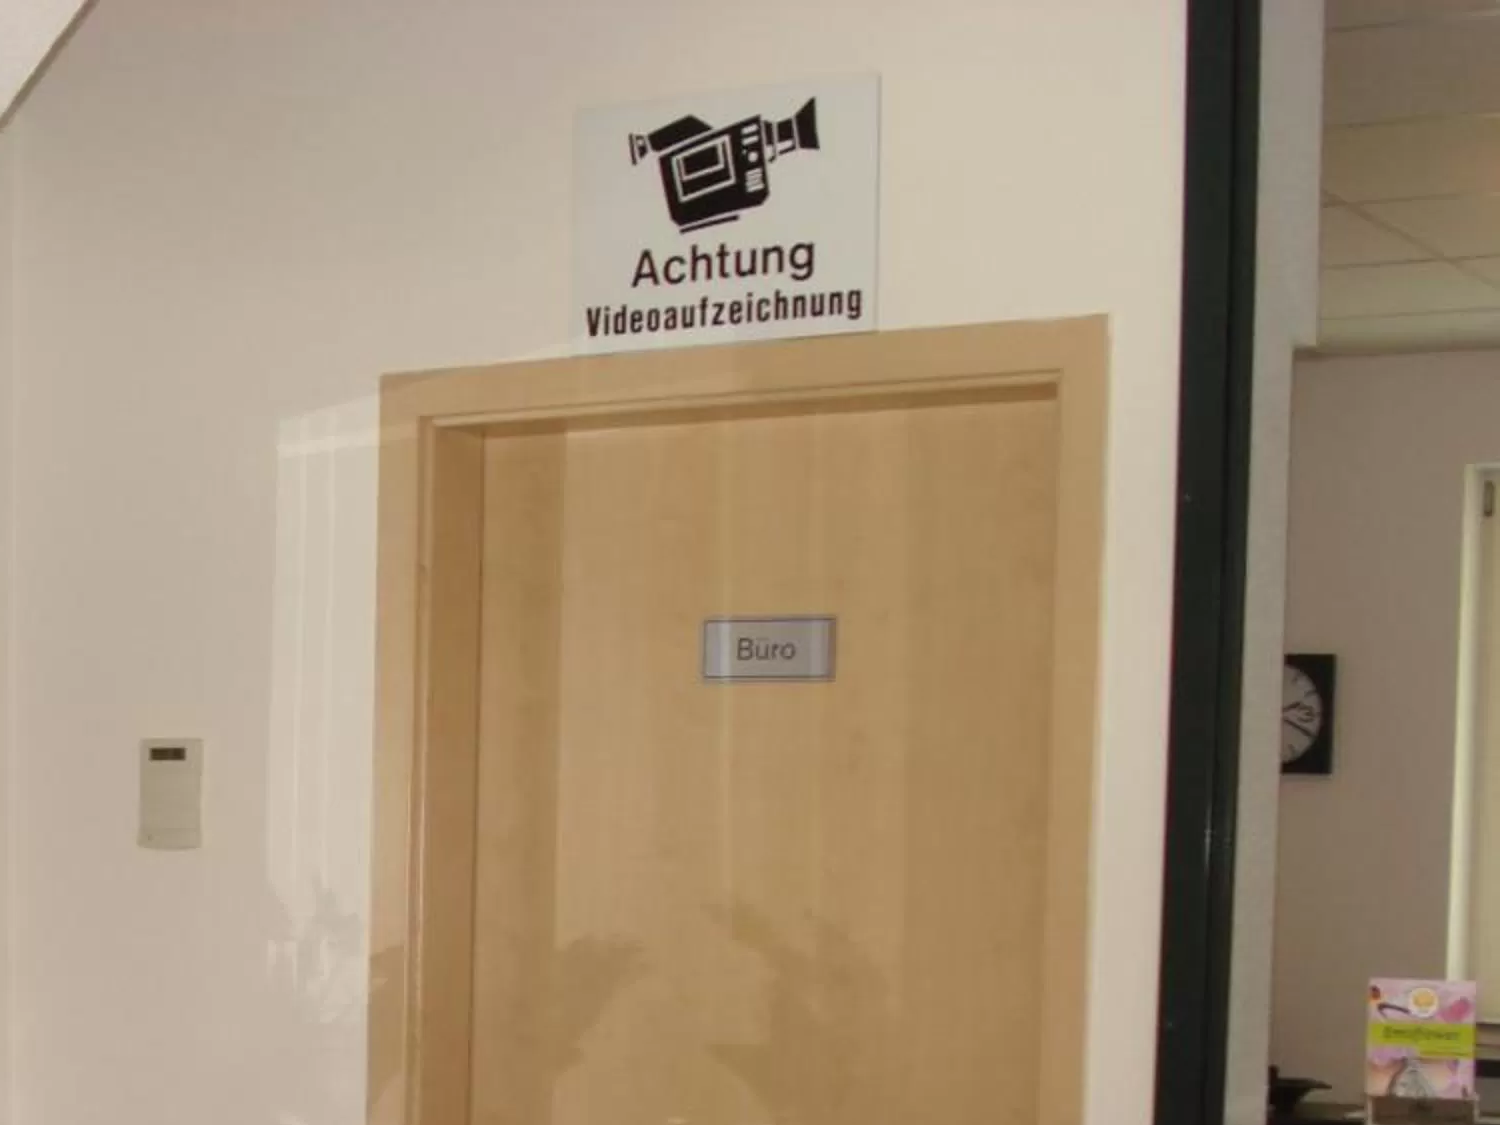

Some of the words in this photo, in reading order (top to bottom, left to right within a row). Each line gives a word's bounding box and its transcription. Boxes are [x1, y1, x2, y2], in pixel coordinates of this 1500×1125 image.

[631, 241, 816, 287] Achtung
[586, 289, 862, 337] Videoaufzeichnung
[736, 636, 797, 661] Büro
